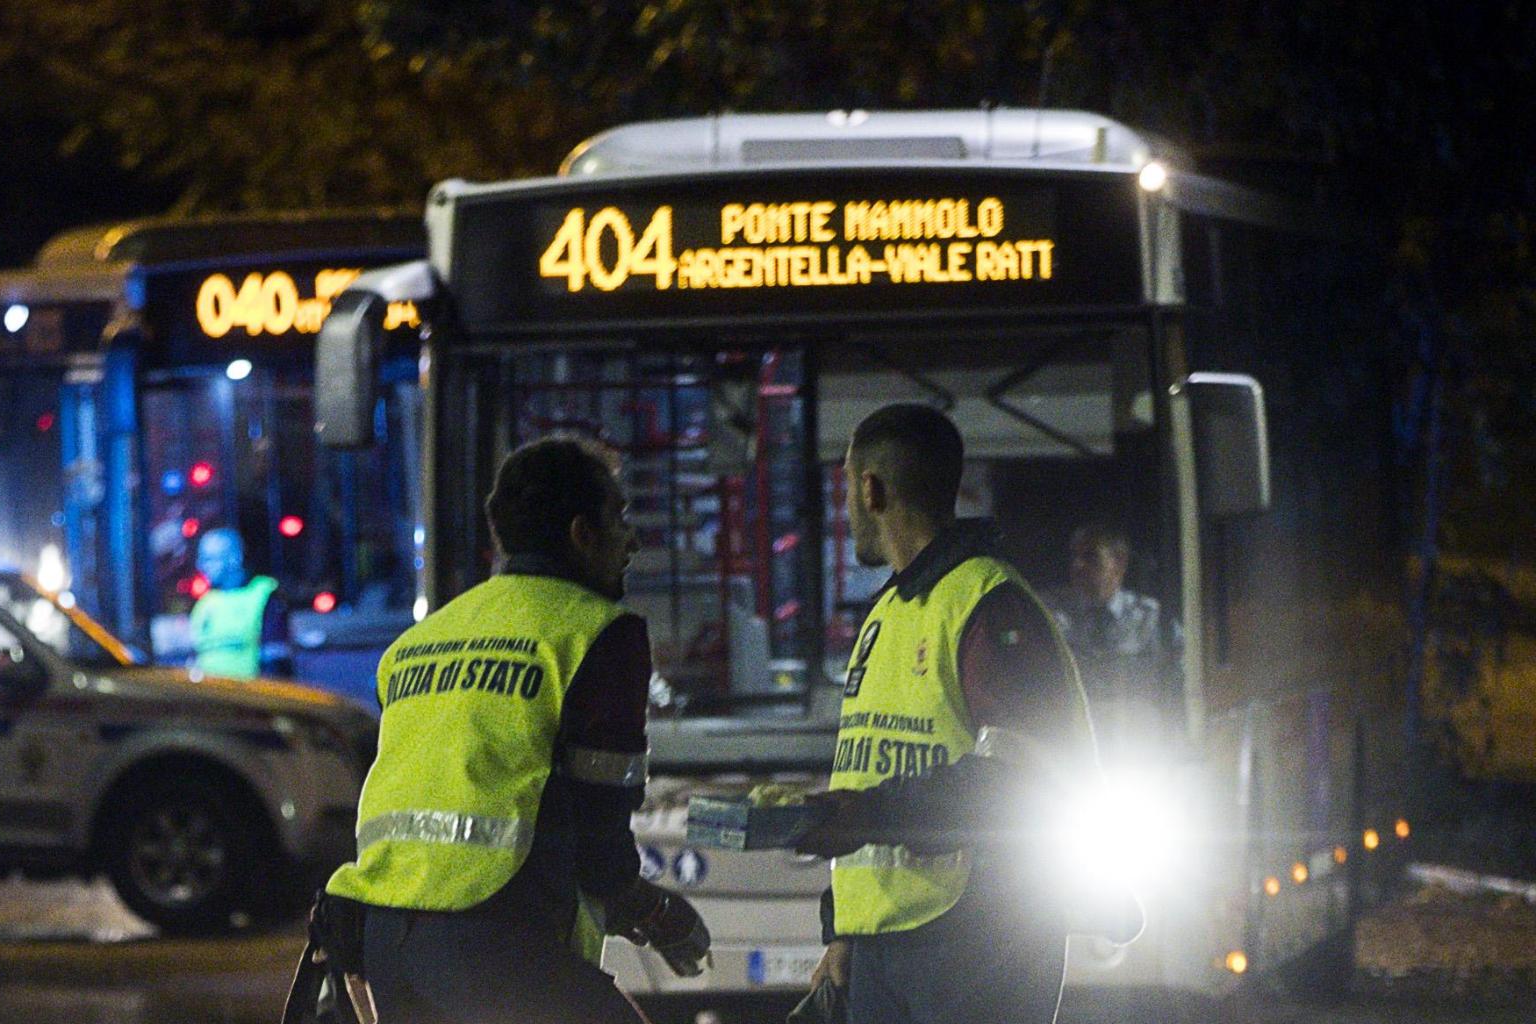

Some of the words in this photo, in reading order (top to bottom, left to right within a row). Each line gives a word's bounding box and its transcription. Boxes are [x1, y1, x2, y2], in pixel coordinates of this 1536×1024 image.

[720, 201, 836, 244] PONTE
[844, 197, 1004, 241] MAMMOLO
[539, 204, 675, 291] 404
[467, 638, 538, 656] NAZIONALE
[385, 662, 437, 707] OLIZIA
[436, 658, 464, 693] di
[461, 658, 543, 700] STATO
[872, 711, 934, 734] NAZIONALE
[875, 738, 948, 776] STATO
